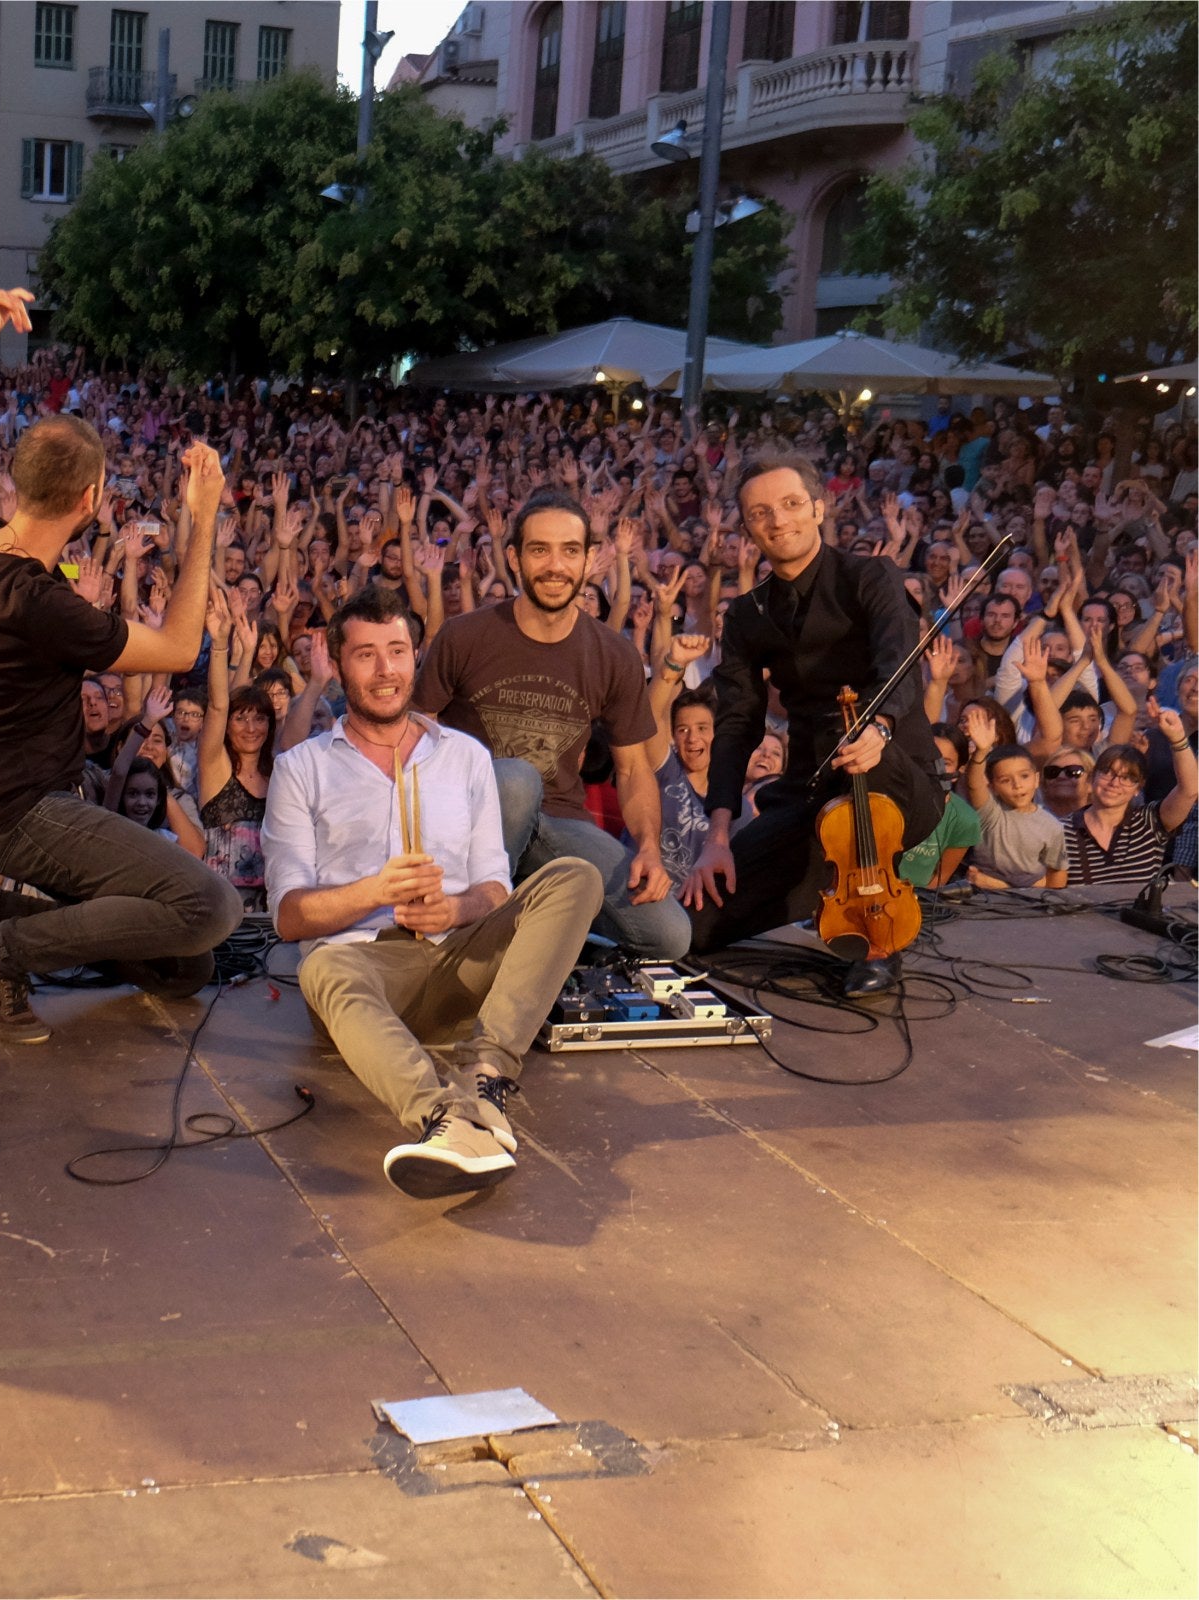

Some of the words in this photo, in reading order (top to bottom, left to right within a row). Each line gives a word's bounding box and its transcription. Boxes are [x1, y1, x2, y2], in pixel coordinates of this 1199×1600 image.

[494, 674, 554, 688] SOCIETY
[554, 680, 579, 698] FOR
[498, 688, 574, 713] PRESERVATION
